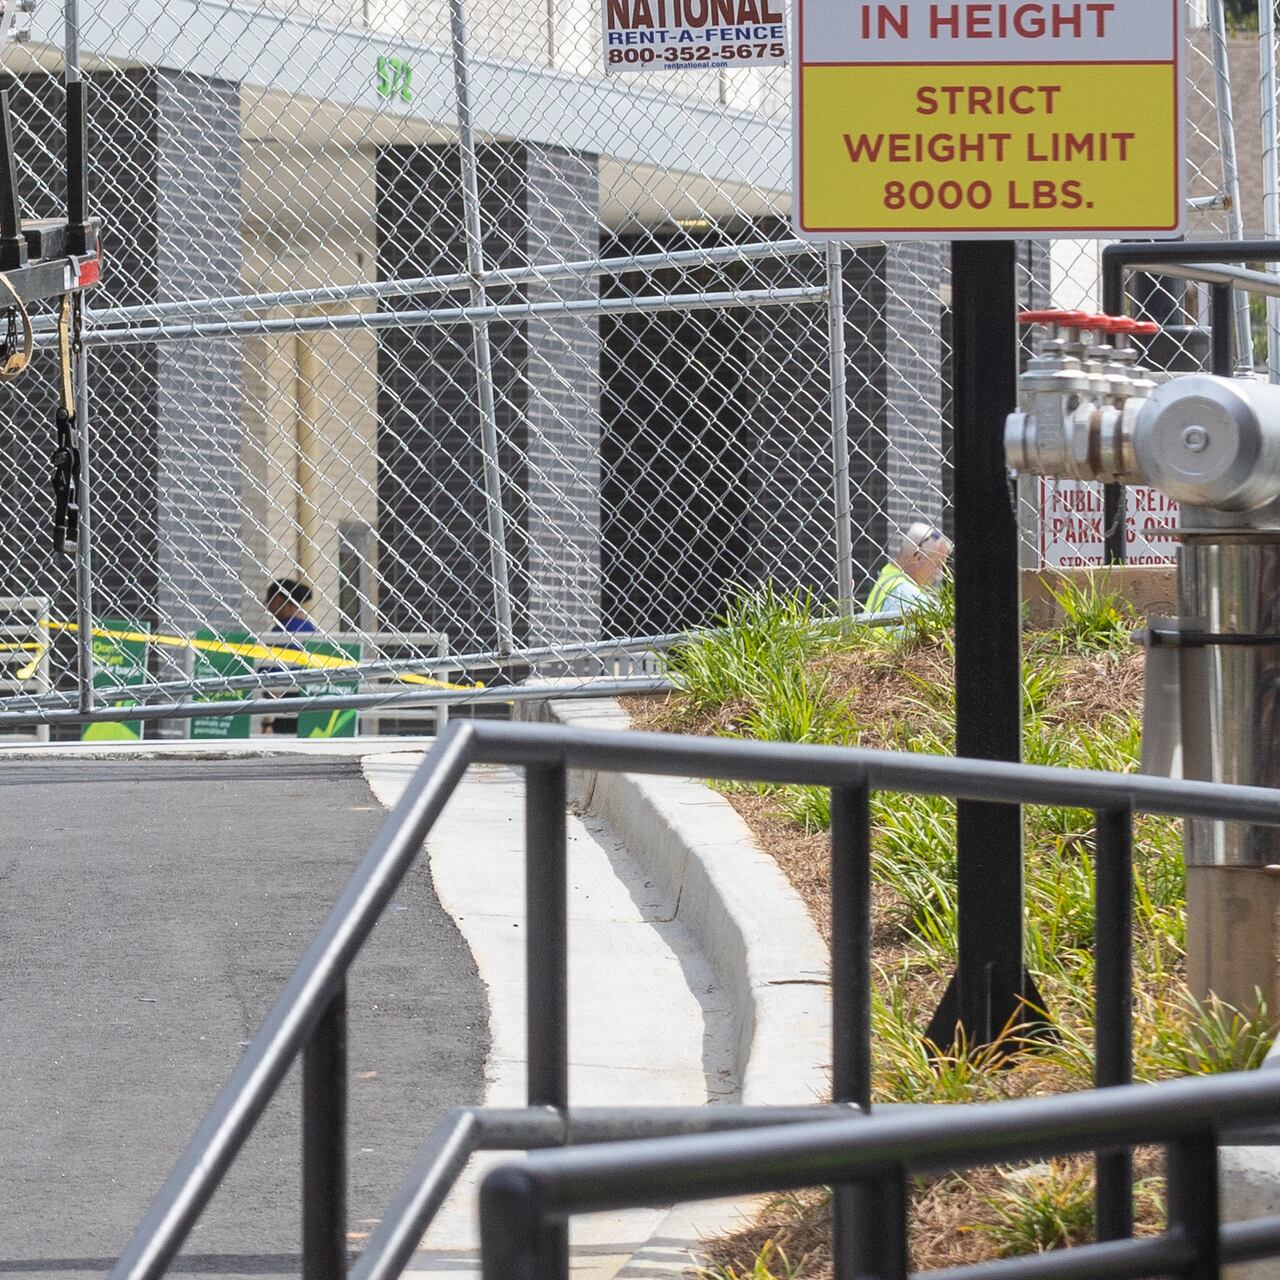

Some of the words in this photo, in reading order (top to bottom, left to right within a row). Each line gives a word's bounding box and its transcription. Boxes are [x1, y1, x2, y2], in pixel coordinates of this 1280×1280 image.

[862, 5, 910, 40] IN
[930, 3, 1116, 40] HEIGHT
[608, 26, 784, 45] RENT-A-FENCE
[608, 43, 785, 64] 800-352-5675
[664, 61, 728, 70] rentnational.com
[915, 85, 1062, 116] STRICT
[843, 133, 1011, 163] WEIGHT
[1027, 132, 1136, 162] LIMIT
[883, 180, 994, 211] 8000
[1008, 180, 1095, 210] LBS.
[1052, 489, 1104, 513] PUBLI
[1136, 489, 1180, 512] RETA
[1052, 517, 1136, 544] PARKG
[1144, 517, 1180, 543] ONL
